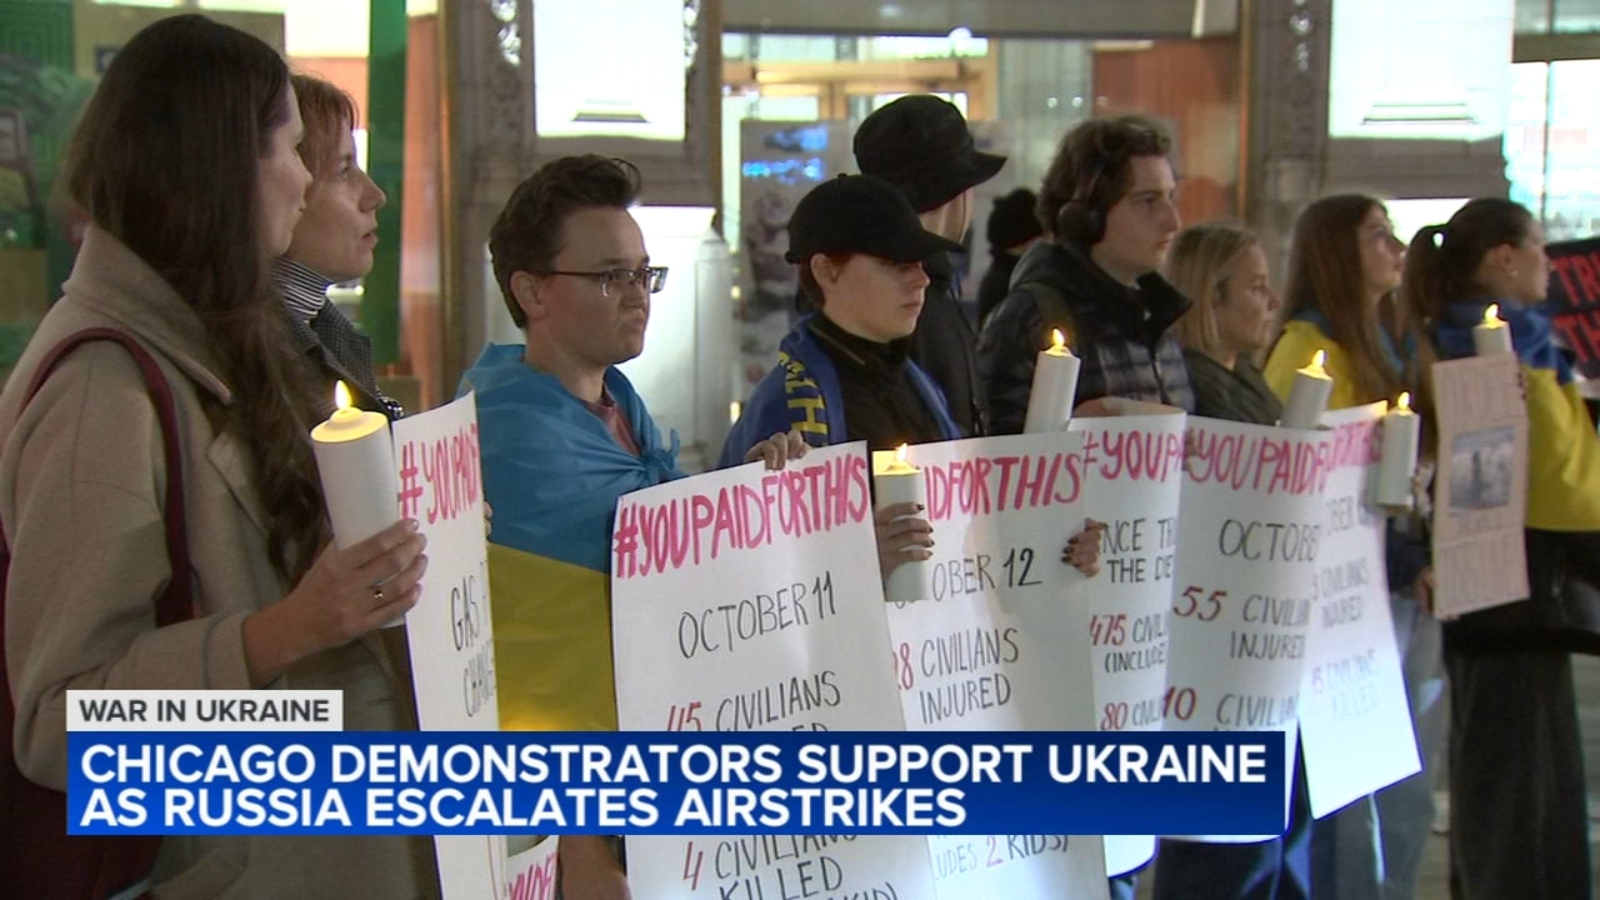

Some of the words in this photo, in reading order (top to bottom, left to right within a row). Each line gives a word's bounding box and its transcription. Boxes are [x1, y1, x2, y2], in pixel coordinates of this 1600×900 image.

[922, 452, 1081, 522] IDFORTHIS
[614, 454, 868, 579] #YOUPAIDFORTHIS
[1102, 518, 1146, 554] NCE
[894, 554, 996, 609] OBER
[1002, 547, 1044, 588] 12
[1106, 557, 1146, 583] THE
[678, 581, 809, 659] OCTOBER
[812, 570, 836, 620] 11
[1173, 585, 1228, 622] 55
[920, 627, 1019, 678] CIVILIANS
[716, 670, 841, 731] CIVILIANS
[919, 673, 1011, 724] INJURED
[1162, 686, 1197, 721] 10
[683, 841, 703, 891] 4
[986, 836, 1004, 867] 2
